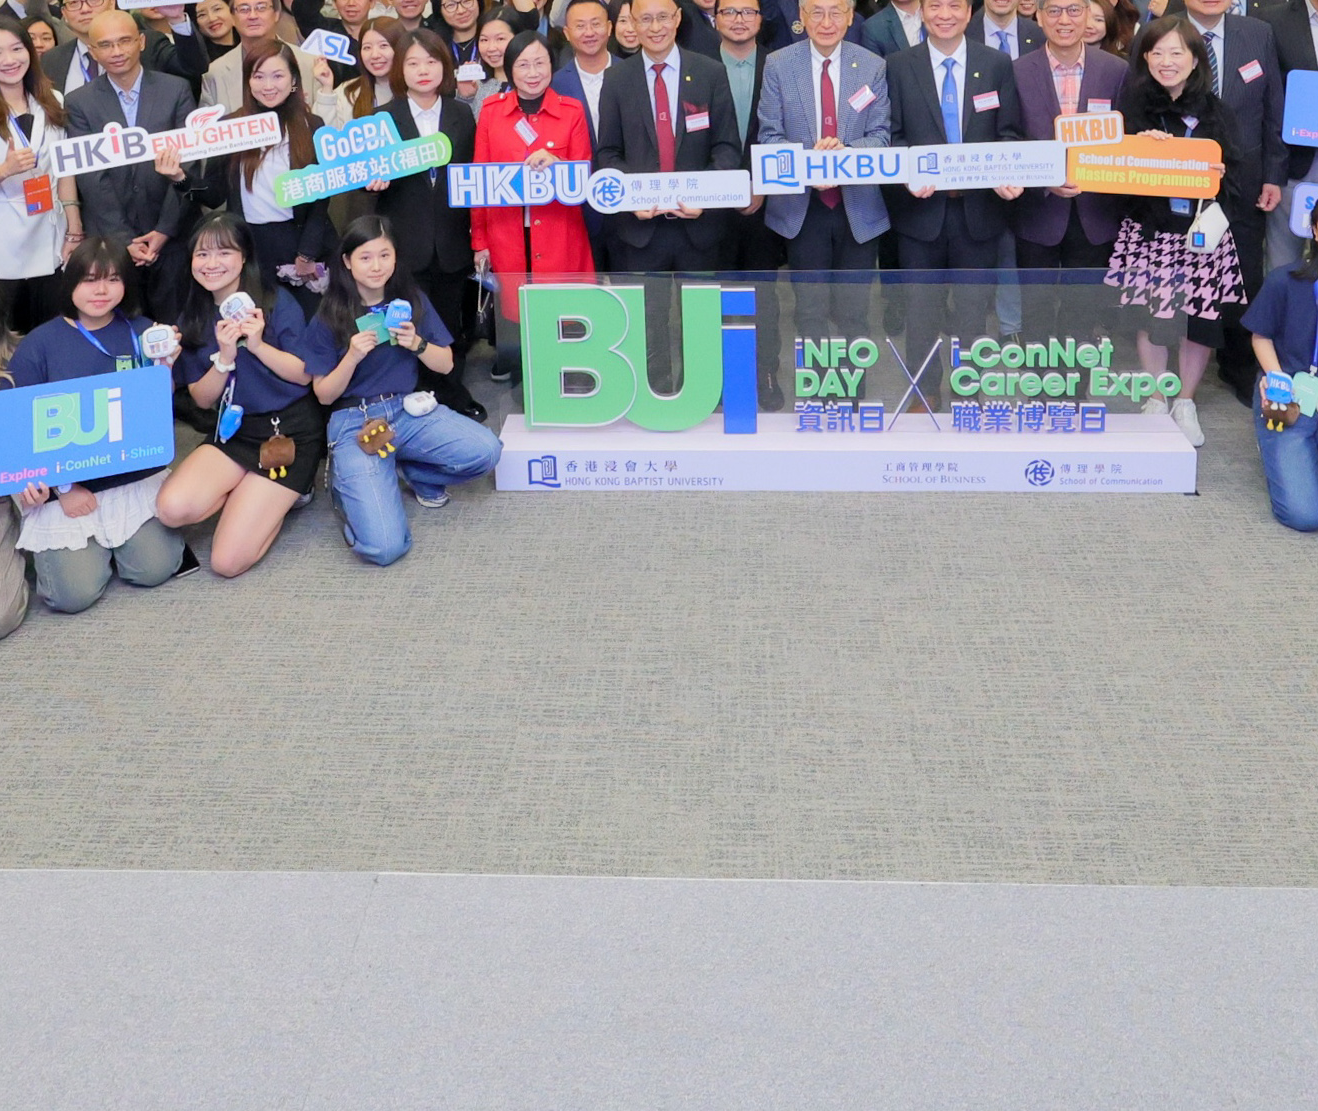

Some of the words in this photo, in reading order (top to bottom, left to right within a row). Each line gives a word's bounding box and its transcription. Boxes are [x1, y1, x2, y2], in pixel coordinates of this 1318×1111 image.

[301, 31, 354, 65] ASL
[319, 120, 395, 161] GoGBA
[1060, 118, 1117, 143] HKBU
[56, 127, 147, 172] HKiB
[208, 146, 228, 155] Future
[229, 140, 253, 153] Banking
[254, 135, 278, 146] Leaders
[943, 152, 1022, 163] 香港浸會大學
[805, 153, 901, 179] HKBU
[943, 165, 962, 173] HONG
[964, 164, 982, 172] KONG
[984, 163, 1012, 172] BAPTIST
[1014, 162, 1055, 171] UNIVERSITY
[1078, 152, 1112, 164] School
[1114, 153, 1126, 165] of
[1127, 156, 1209, 171] Communication
[449, 163, 589, 206] HKBU
[631, 178, 699, 190] 傳理學院
[1075, 167, 1126, 184] Masters
[1128, 169, 1210, 188] Programmes
[631, 191, 659, 205] School
[661, 191, 670, 204] of
[675, 191, 744, 204] Communication
[519, 283, 757, 434] BUi
[950, 337, 1113, 369] i-ConNet
[795, 366, 865, 397] DAY
[950, 369, 1080, 397] Career
[1090, 368, 1182, 402] Expo
[31, 387, 124, 454] BUi
[794, 401, 884, 433] 資訊日
[951, 401, 1107, 433] 職業博覽日
[55, 454, 111, 475] i-ConNet
[121, 444, 164, 462] i-Shine
[565, 460, 678, 473] 香港浸會大學
[883, 462, 959, 472] 工商管理學院
[1059, 463, 1123, 475] 傳理學院
[565, 477, 590, 486] HONG
[594, 477, 620, 486] KONG
[624, 477, 664, 486] BAPTIST
[668, 477, 724, 486] UNIVERSITY
[882, 475, 922, 484] SCHOOL
[925, 475, 937, 484] OF
[940, 474, 986, 484] BUSINESS
[1059, 477, 1084, 486] School
[1087, 477, 1097, 486] of
[1100, 476, 1163, 486] Communication
